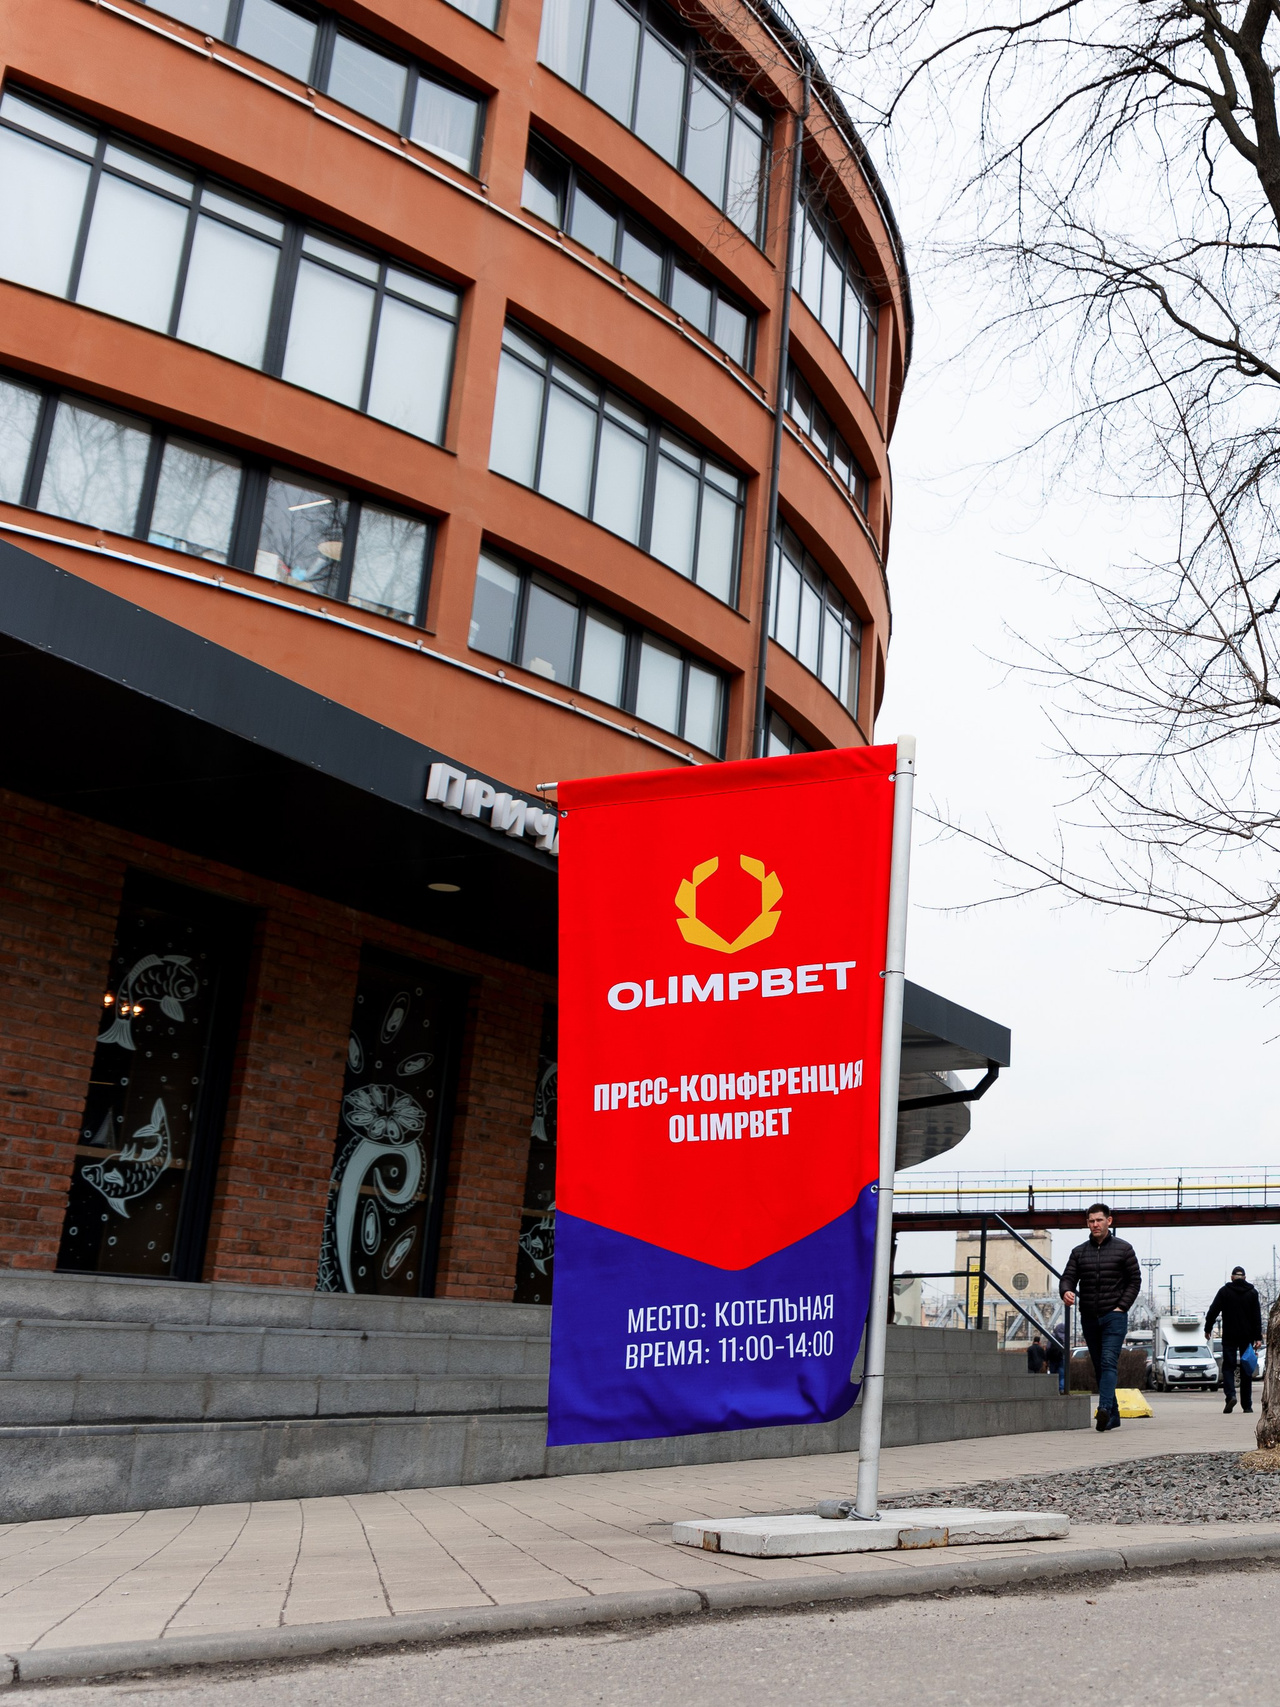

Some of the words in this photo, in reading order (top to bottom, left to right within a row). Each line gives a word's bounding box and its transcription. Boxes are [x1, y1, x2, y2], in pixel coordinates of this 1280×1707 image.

[426, 762, 559, 856] ПРИЧ
[607, 960, 857, 1011] OLIMPBET
[593, 1059, 864, 1112] ПРЕСС-КОНФЕРЕНЦИЯ
[668, 1107, 793, 1143] OLIMPBET
[627, 1303, 708, 1334] МЕСТО:
[715, 1293, 834, 1328] КОТЕЛЬНАЯ
[625, 1337, 710, 1370] ВРЕМЯ:
[718, 1329, 834, 1363] 11:00-14:00
